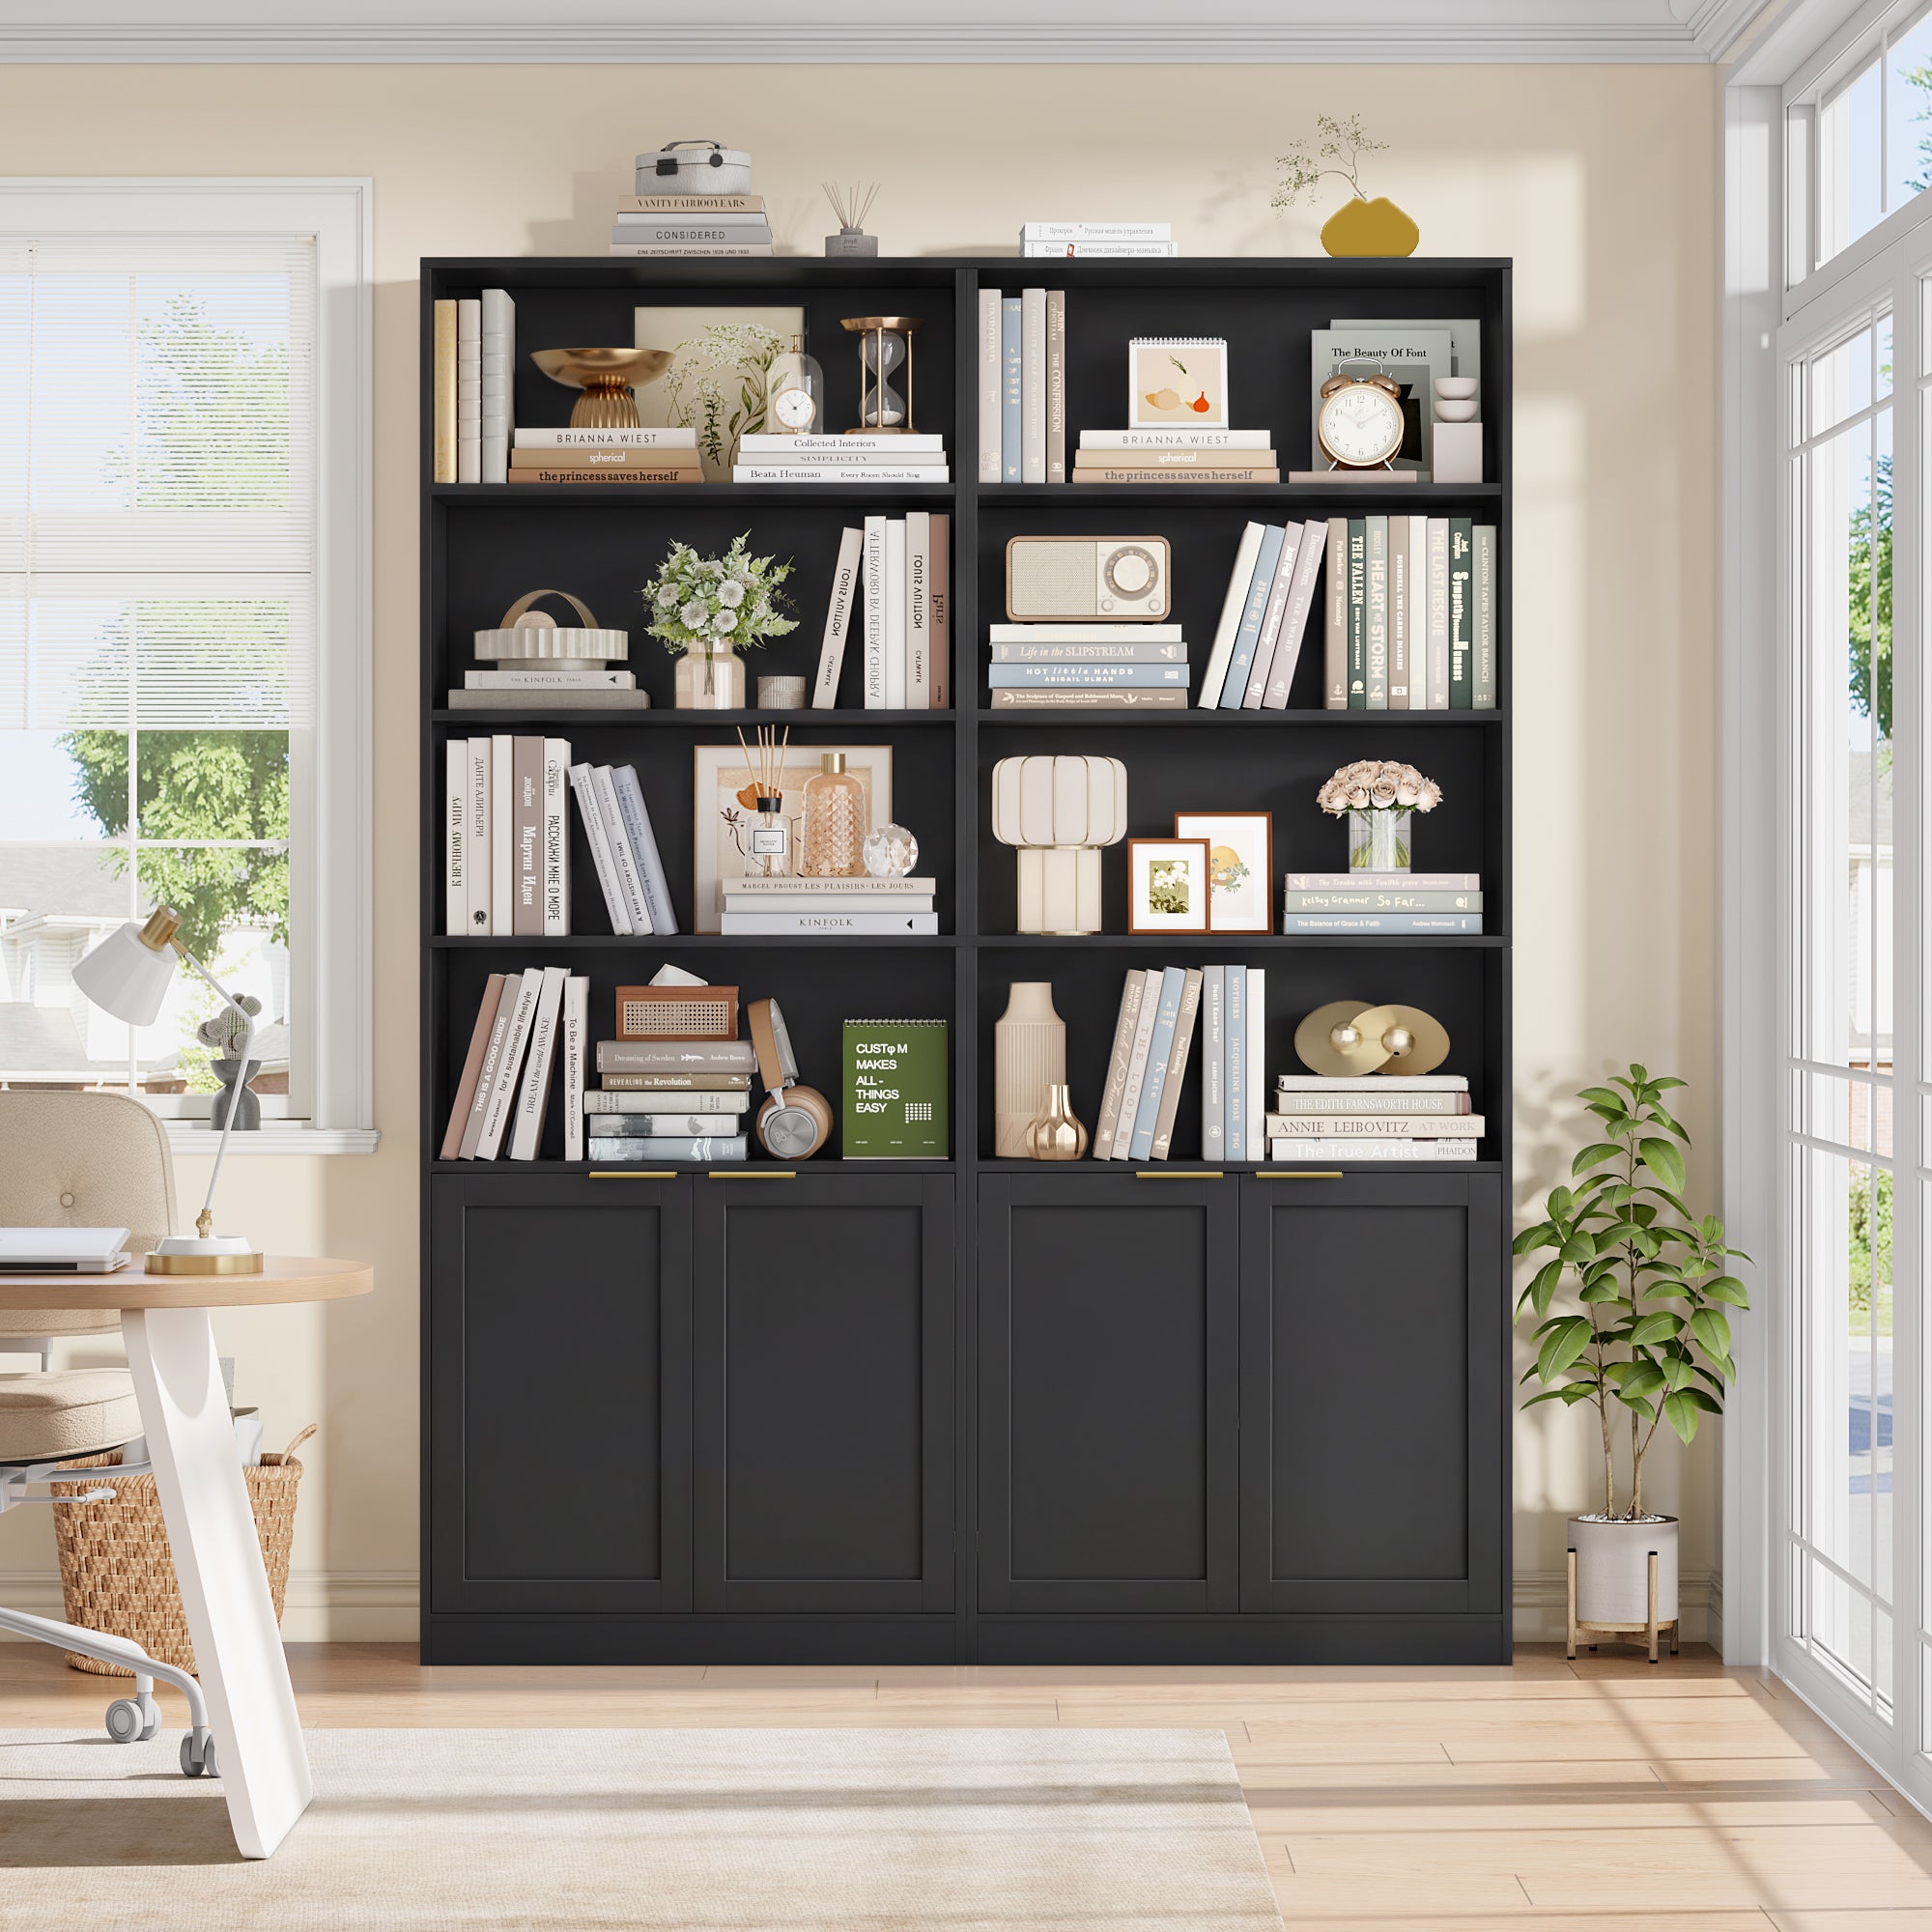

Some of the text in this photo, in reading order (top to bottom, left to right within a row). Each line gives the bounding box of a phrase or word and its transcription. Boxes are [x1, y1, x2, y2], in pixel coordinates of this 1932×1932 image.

[656, 231, 725, 240] CONSIDERED
[1332, 348, 1427, 358] The Beauty Of Font
[1052, 369, 1062, 433] CONFESSION
[556, 435, 657, 443] BRIANNA WIEST
[1122, 436, 1230, 444] BRIANNA WIEST
[589, 451, 626, 465] spherical
[1158, 452, 1197, 465] spherical
[539, 471, 558, 481] the
[559, 471, 607, 483] princess
[639, 471, 679, 481] herself
[751, 469, 821, 478] Beata Heuman
[1105, 471, 1124, 480] the
[1126, 471, 1178, 482] princess
[1211, 471, 1254, 480] herself
[1432, 528, 1445, 553] THE
[1453, 532, 1463, 559] Compton
[1281, 545, 1296, 578] Just Fall
[1352, 536, 1364, 605] THE FALLEN
[1432, 556, 1445, 586] LAST
[1371, 559, 1384, 612] HEART
[1334, 596, 1343, 626] Noonday
[1432, 589, 1445, 636] RESCUE
[1019, 647, 1037, 659] Life
[1039, 647, 1048, 657] in
[1051, 647, 1063, 657] the
[1065, 647, 1134, 657] SLIPSTREAM
[1371, 624, 1384, 679] STORM
[452, 796, 463, 827] МИРУ
[548, 815, 559, 862] РАССКАЖИ
[616, 841, 625, 857] TIME
[452, 831, 462, 877] ВЕЧНОМУ
[520, 825, 536, 905] Мартин Иден
[621, 859, 628, 867] OF
[548, 866, 559, 885] МНЕ
[624, 869, 636, 896] HISTORY
[548, 896, 559, 921] МОРЕ
[632, 898, 641, 916] BRIEF
[1377, 895, 1391, 907] So
[1131, 985, 1142, 1013] MAEVE
[1185, 984, 1197, 1013] ENON
[537, 1016, 551, 1050] AWAKE
[569, 1018, 578, 1028] To
[498, 1080, 507, 1092] for
[505, 1024, 524, 1071] sustainable
[517, 991, 531, 1023] lifestyle
[569, 1031, 578, 1042] Be
[475, 1093, 486, 1113] THIS
[483, 1082, 489, 1092] IS
[486, 1046, 498, 1072] GOOD
[494, 1016, 506, 1045] GUIDE
[535, 1050, 544, 1068] world
[614, 1054, 644, 1063] Dreaming
[856, 1060, 896, 1069] MAKES
[1172, 1036, 1186, 1075] Paul Harding
[1231, 1037, 1240, 1093] JACQUELINE
[569, 1053, 578, 1090] Machine
[856, 1076, 877, 1086] ALL
[1124, 1027, 1150, 1119] THE LOOP
[1151, 1061, 1167, 1098] Kate
[526, 1080, 539, 1114] DREAM
[856, 1090, 899, 1099] THINGS
[1293, 1098, 1443, 1109] THE EDITH FARNSWORTH HOUSE
[856, 1103, 887, 1113] EASY
[1232, 1098, 1240, 1122] ROSE
[1278, 1122, 1475, 1133] ANNIE LEIBOVITZ AT WORK
[1232, 1132, 1240, 1149] FSG
[1295, 1144, 1476, 1158] The True Artist PHAIDON
